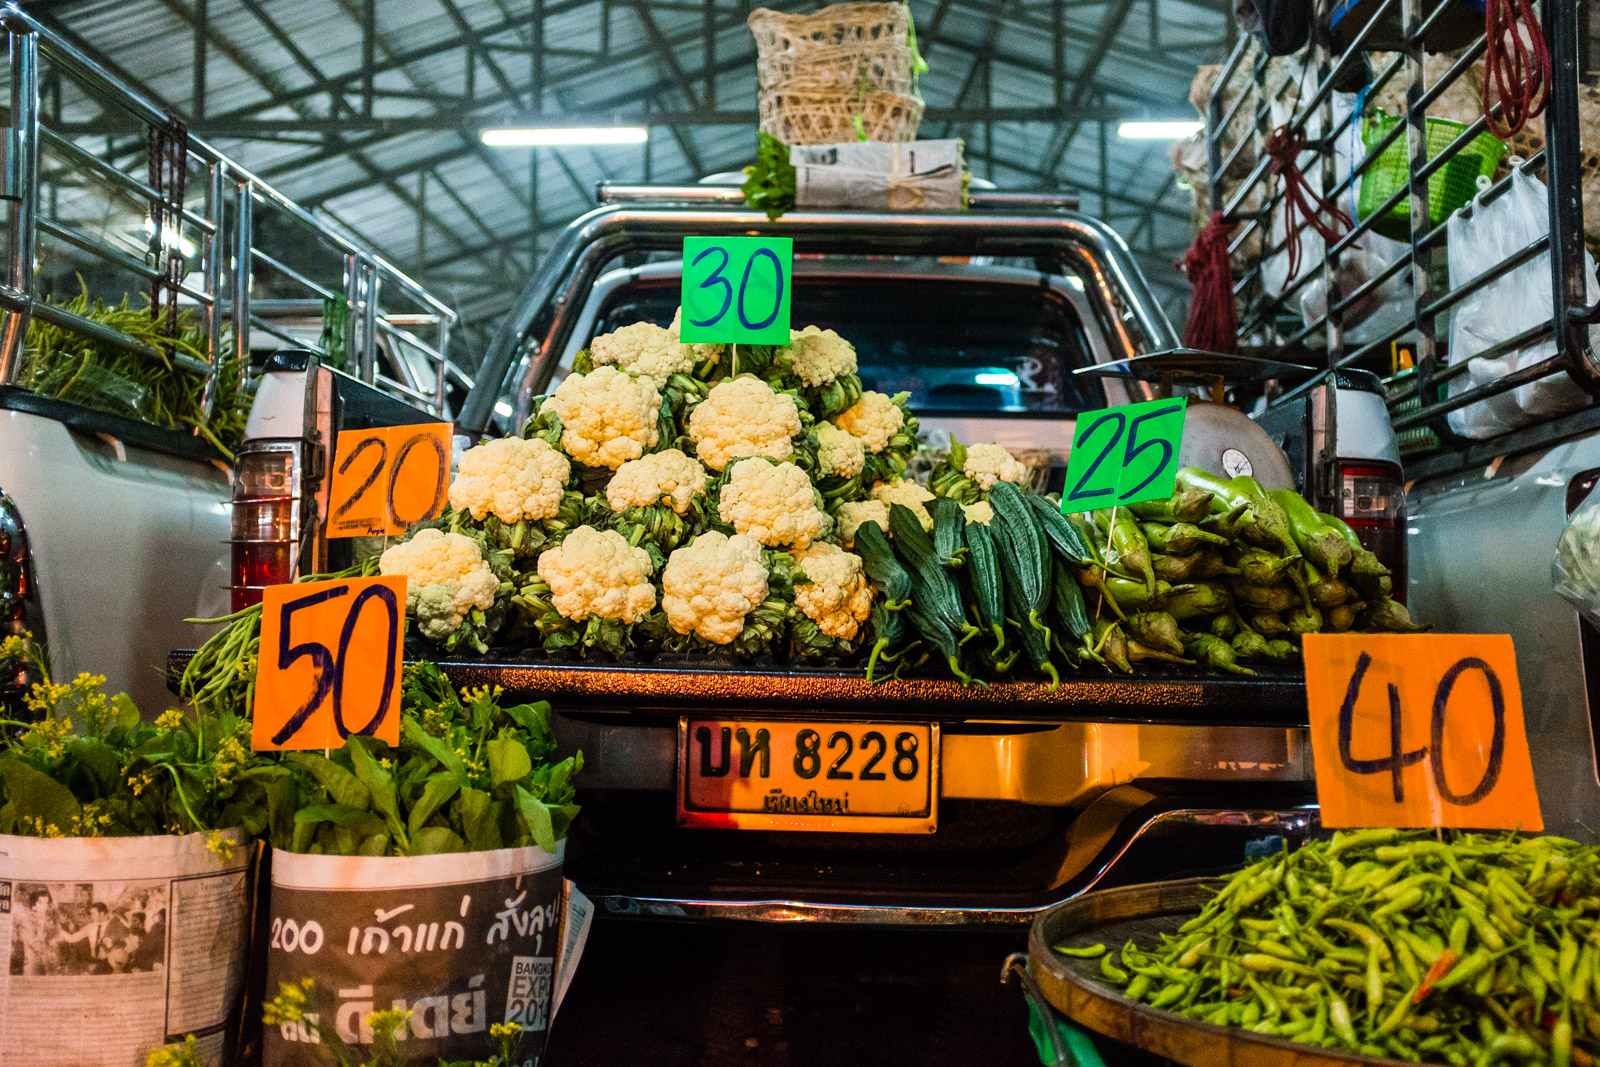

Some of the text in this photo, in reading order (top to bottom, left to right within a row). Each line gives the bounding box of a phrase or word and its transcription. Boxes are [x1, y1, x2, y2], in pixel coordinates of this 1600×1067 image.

[689, 247, 783, 330] 30
[331, 433, 445, 529] 20
[1067, 405, 1182, 501] 25
[271, 584, 398, 746] 50
[794, 728, 918, 781] 8228
[1338, 651, 1505, 806] 40
[764, 788, 848, 813] เชียงใหม่
[271, 917, 324, 954] 200
